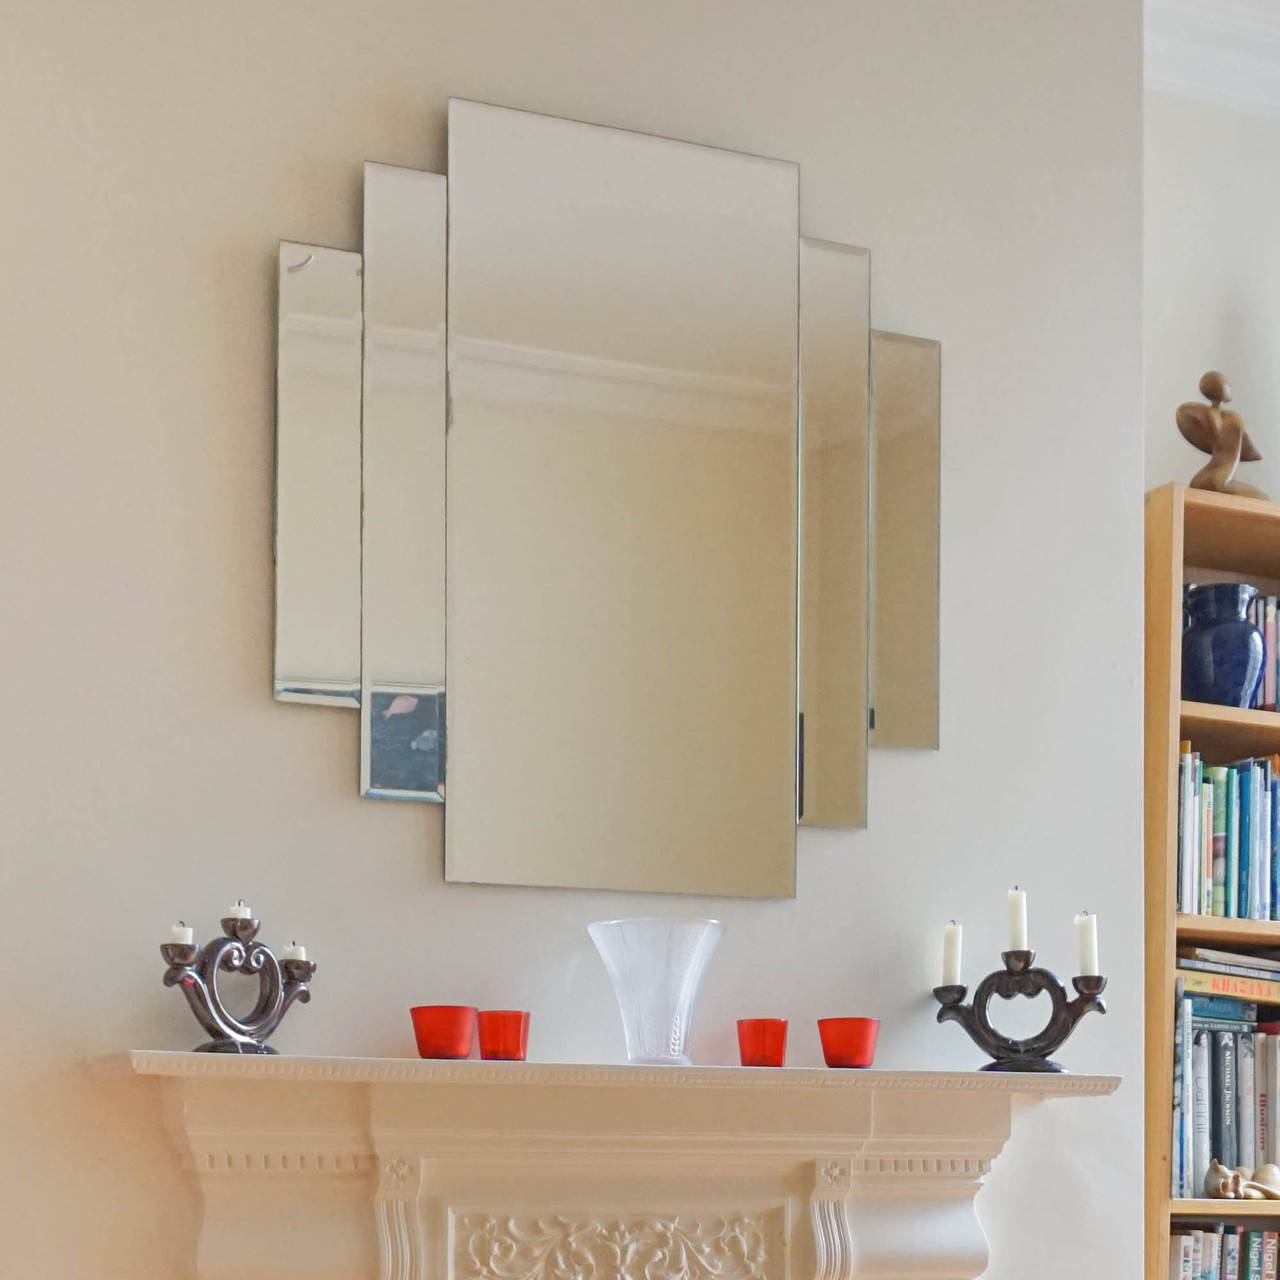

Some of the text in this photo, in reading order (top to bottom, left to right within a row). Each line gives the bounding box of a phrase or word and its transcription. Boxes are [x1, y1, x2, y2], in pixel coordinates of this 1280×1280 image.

[1224, 1089, 1232, 1126] JACKSON
[1250, 1237, 1261, 1271] Nigel
[1263, 1238, 1276, 1274] Nigel
